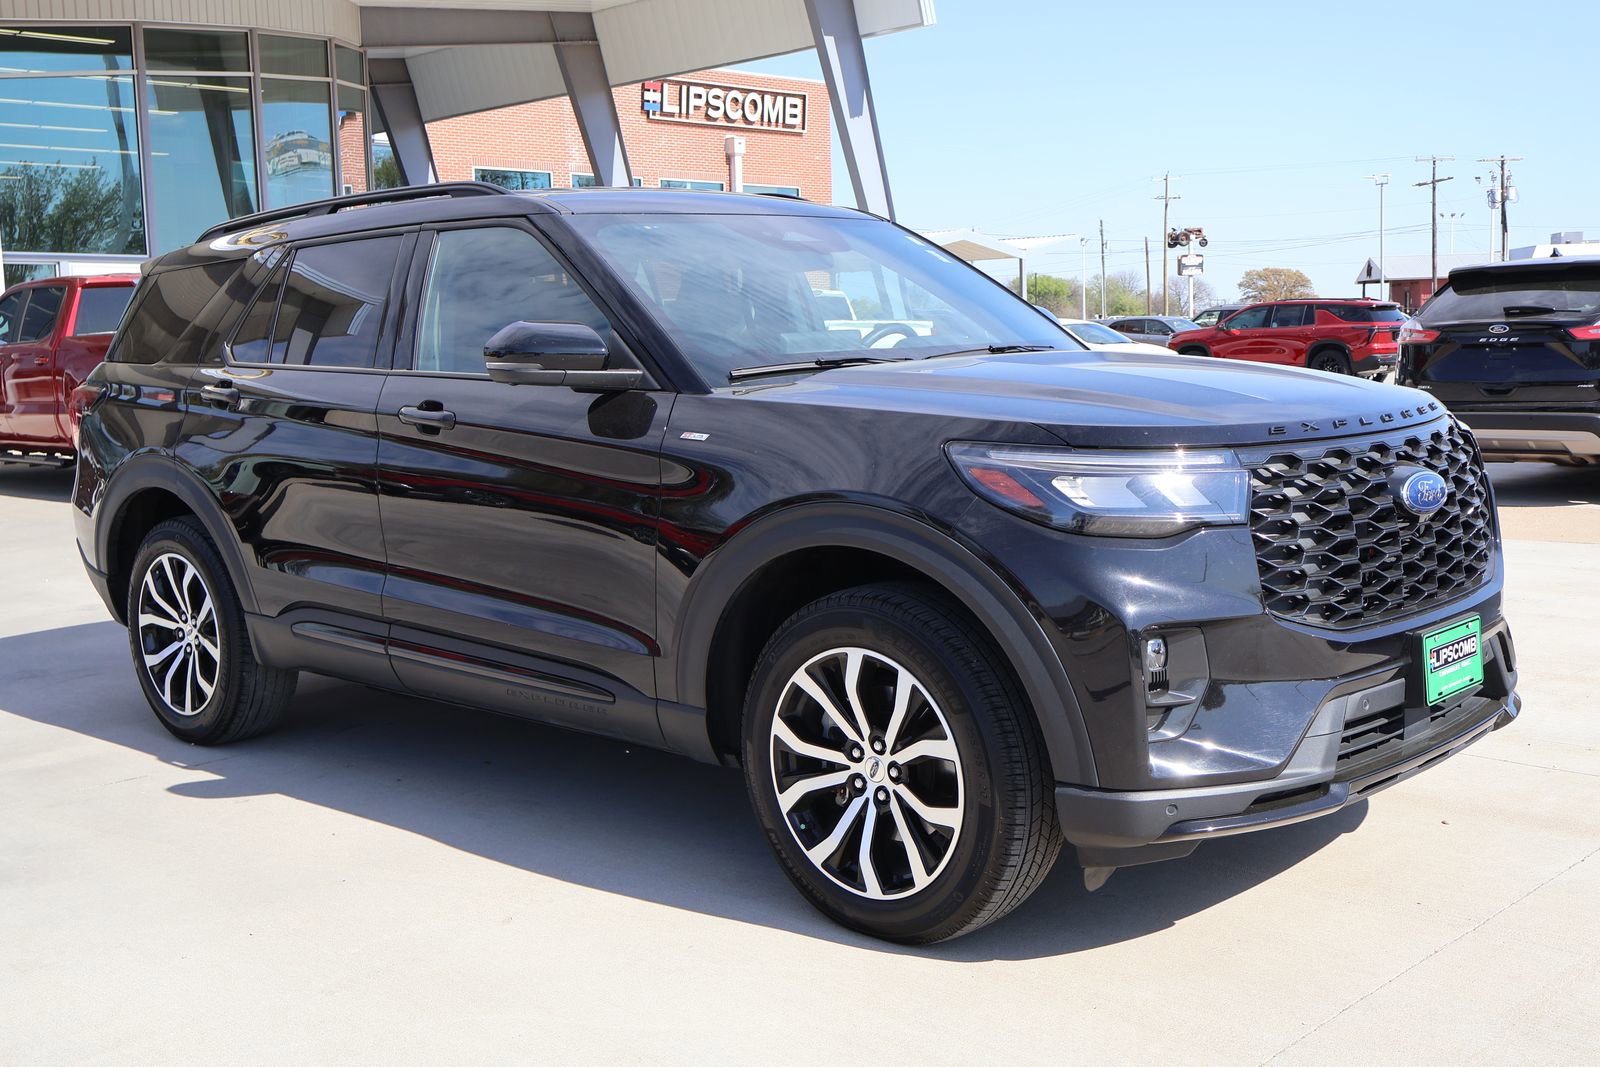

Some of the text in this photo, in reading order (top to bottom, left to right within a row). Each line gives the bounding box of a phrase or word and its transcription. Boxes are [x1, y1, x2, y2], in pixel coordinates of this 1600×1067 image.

[662, 83, 801, 125] LIPSCOMB
[1268, 401, 1438, 436] EXPLORER
[1418, 480, 1443, 505] Ford
[1433, 636, 1477, 667] LIPSCOMB
